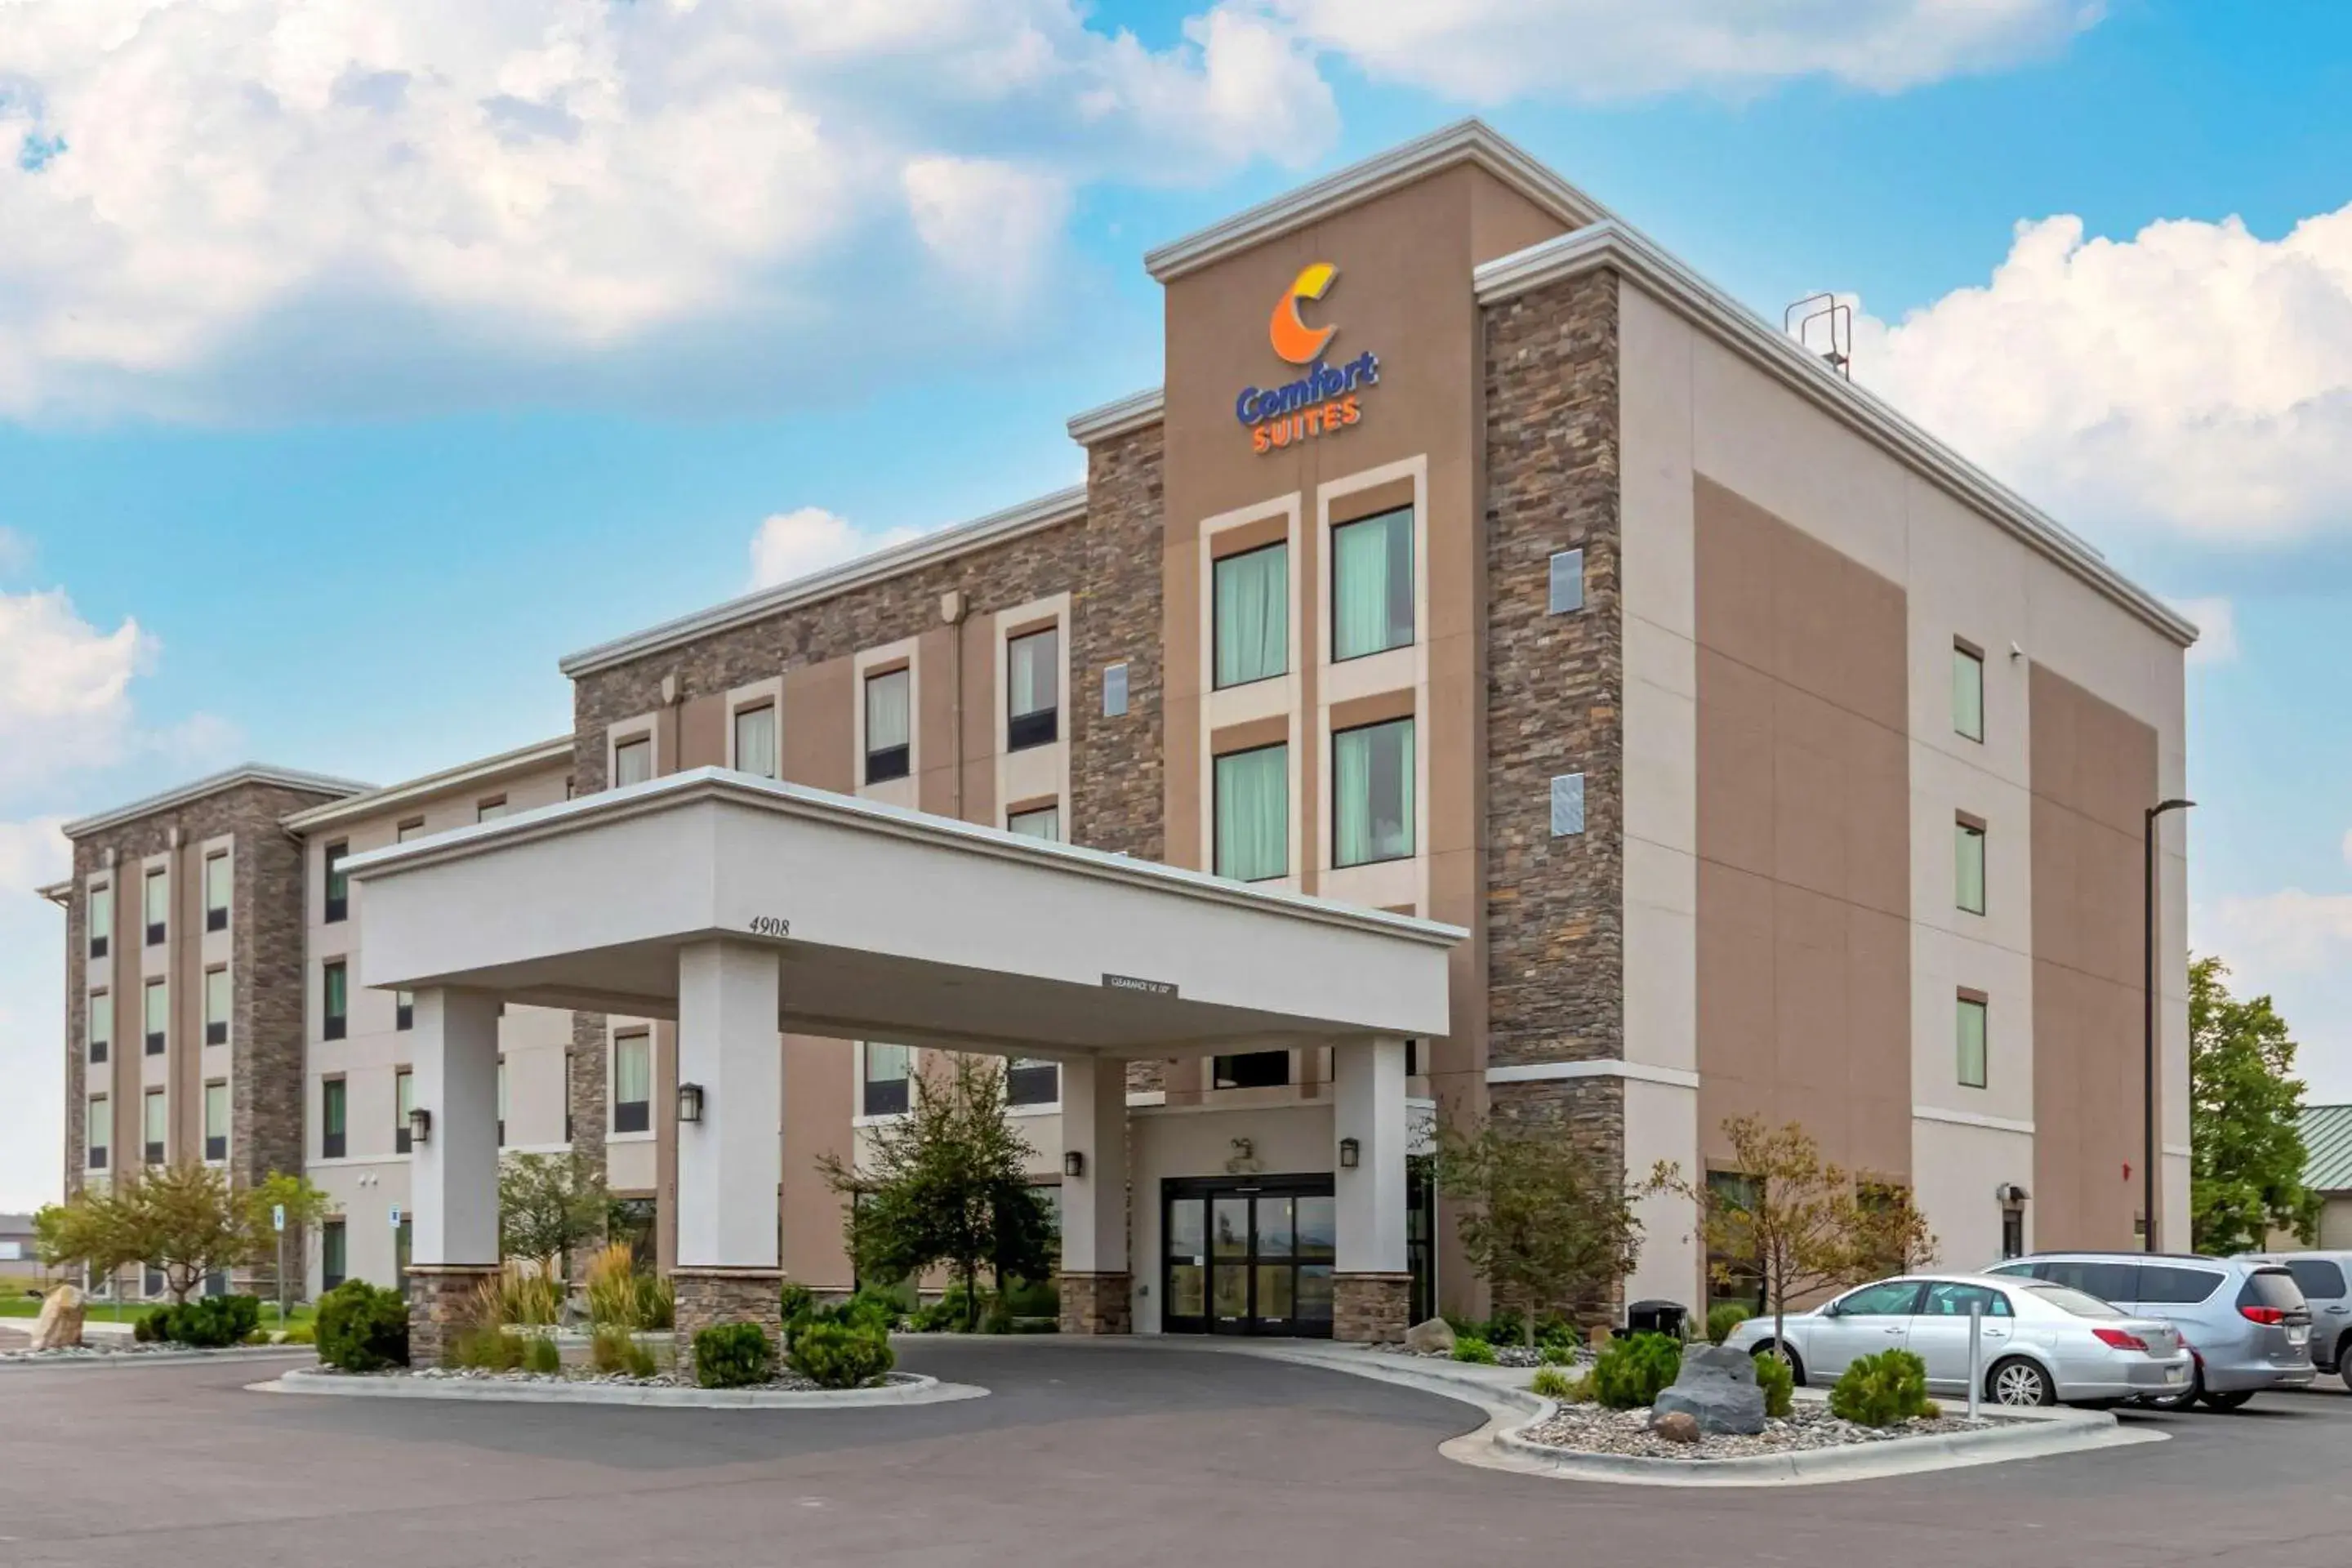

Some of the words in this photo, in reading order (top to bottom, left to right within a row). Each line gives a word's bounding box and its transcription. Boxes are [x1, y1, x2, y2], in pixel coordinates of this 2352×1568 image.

[1236, 350, 1379, 424] Comfort
[1253, 394, 1361, 454] SUITES
[749, 915, 790, 937] 4908
